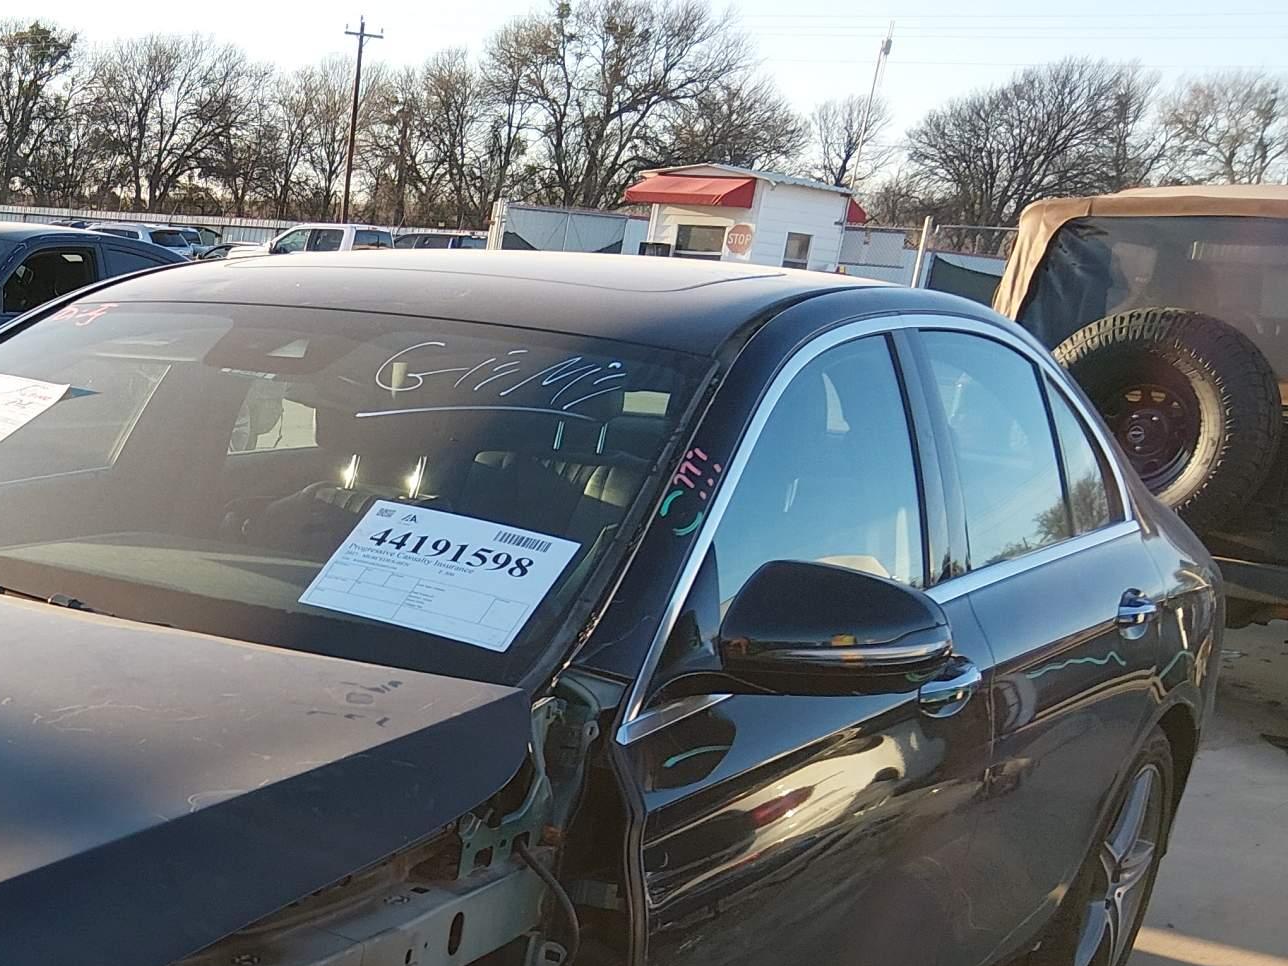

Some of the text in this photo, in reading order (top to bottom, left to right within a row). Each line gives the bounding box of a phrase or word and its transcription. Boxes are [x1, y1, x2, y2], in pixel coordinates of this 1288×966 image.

[727, 232, 752, 246] STOP
[348, 542, 395, 558] Progressive
[396, 551, 431, 566] Casualty
[433, 558, 475, 575] Insurance
[369, 527, 534, 578] 44191598
